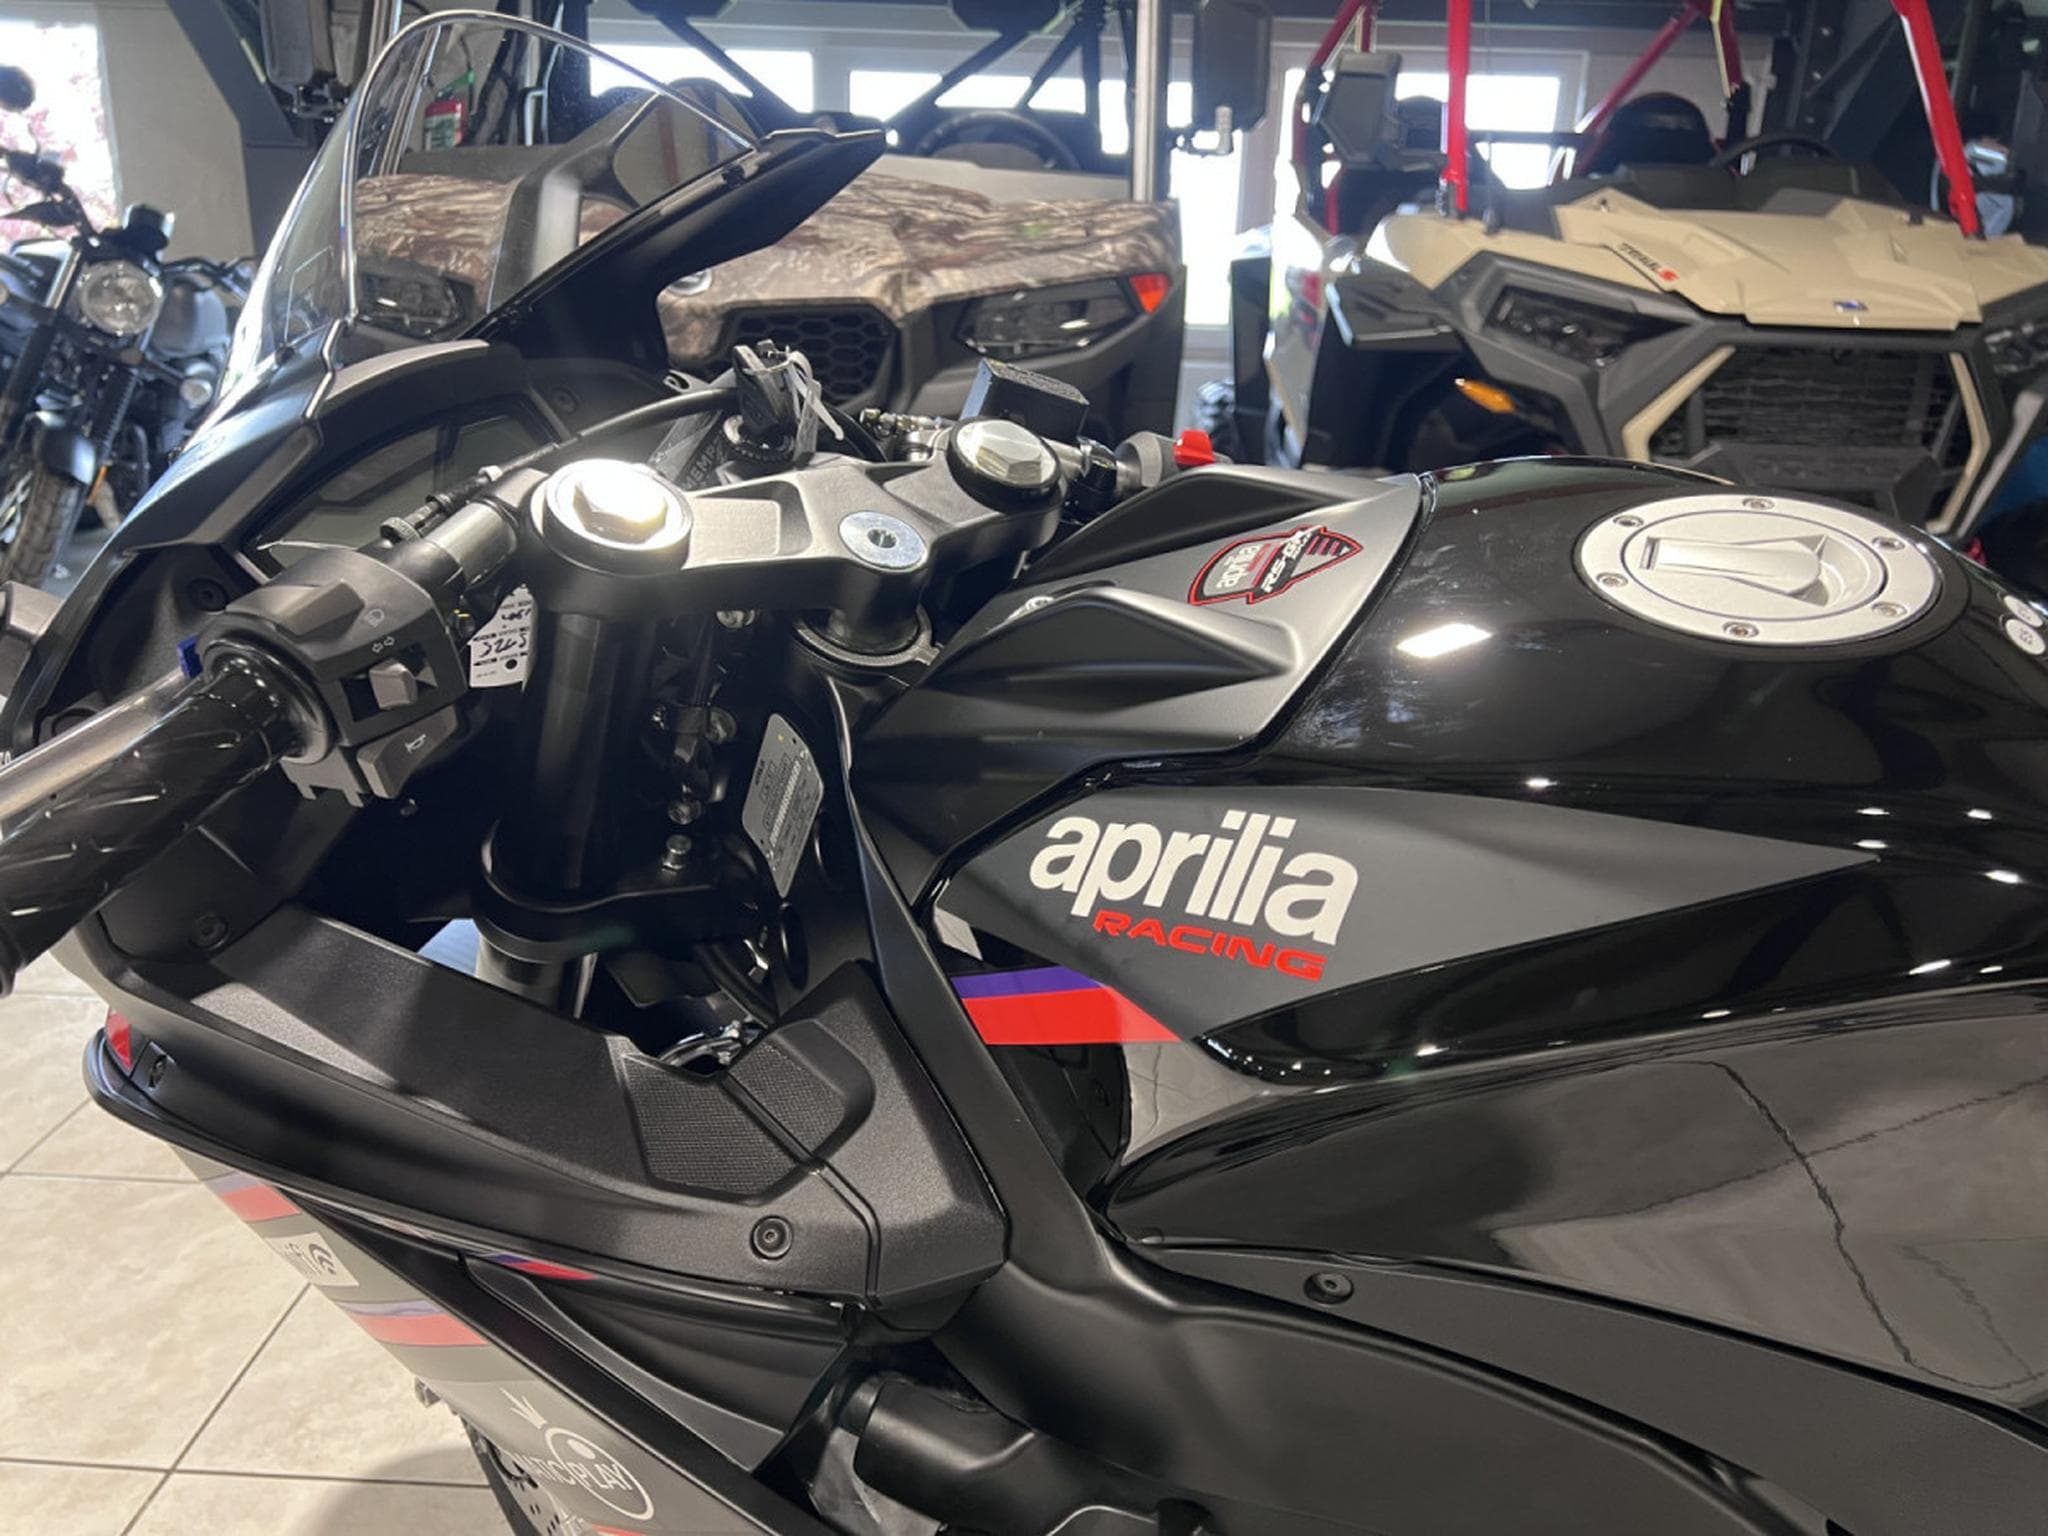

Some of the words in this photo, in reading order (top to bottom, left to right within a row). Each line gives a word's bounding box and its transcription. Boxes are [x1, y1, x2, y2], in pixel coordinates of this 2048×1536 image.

[1029, 810, 1359, 946] aprilia
[1093, 909, 1328, 983] RACING
[564, 1461, 633, 1491] PLAY
